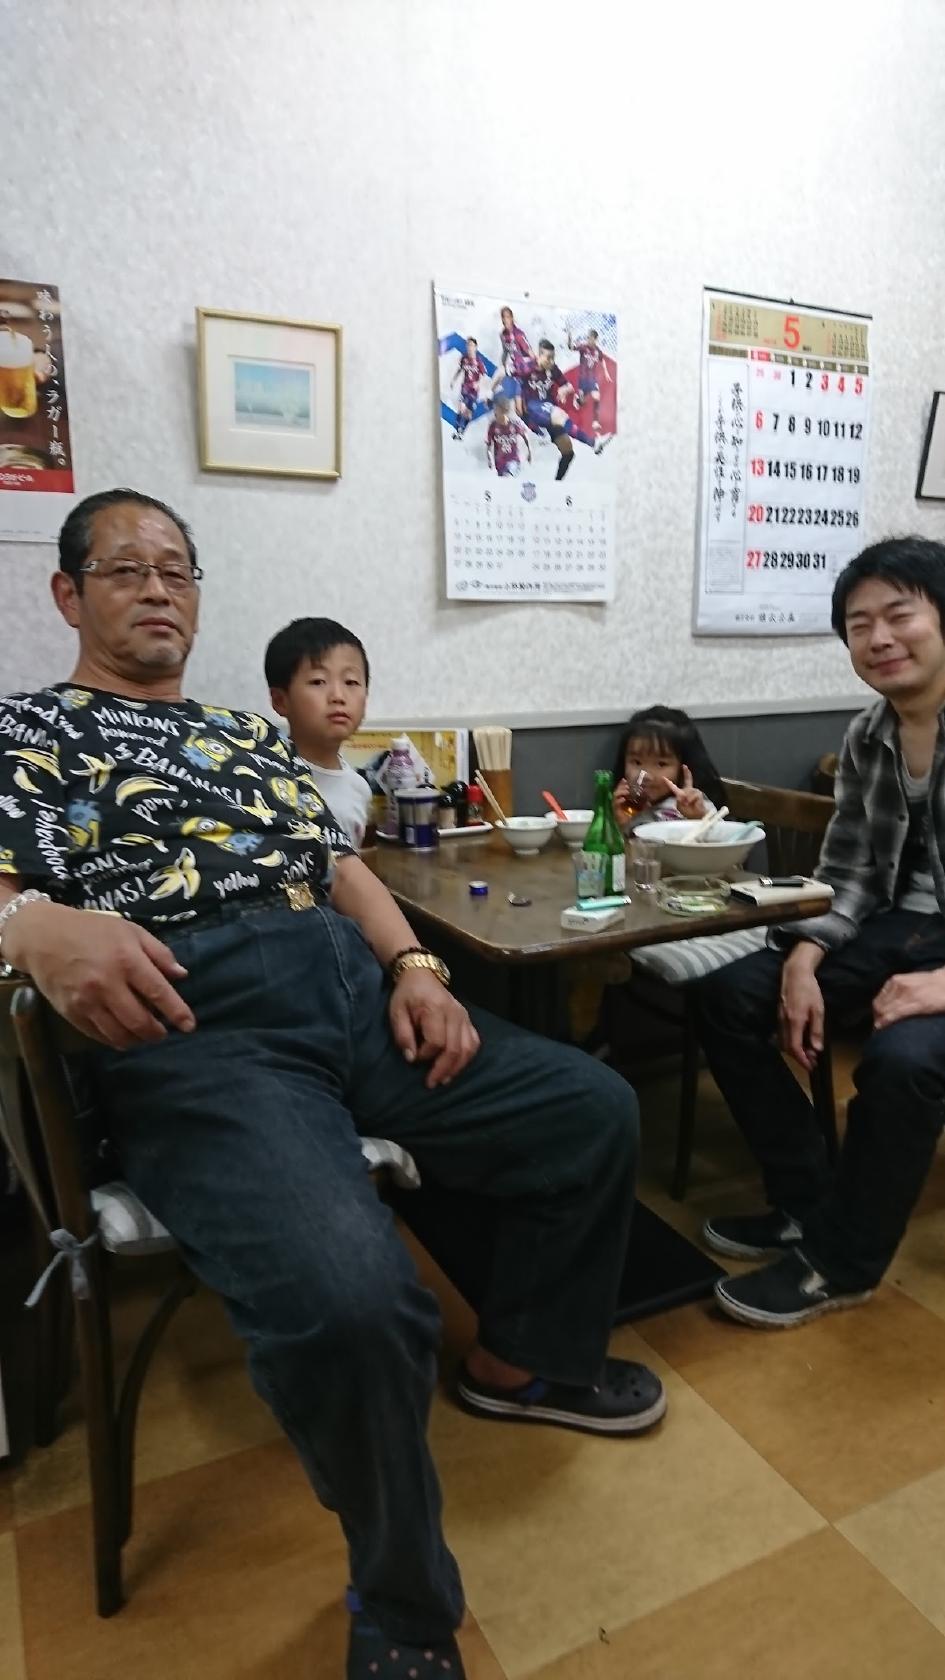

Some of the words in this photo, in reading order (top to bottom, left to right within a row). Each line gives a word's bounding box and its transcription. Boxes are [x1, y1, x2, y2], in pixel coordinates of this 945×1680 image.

[783, 314, 801, 350] 5
[790, 371, 796, 387] 1
[805, 372, 813, 388] 2
[820, 374, 829, 392] 3
[837, 376, 846, 393] 4
[854, 377, 863, 395] 5
[755, 410, 764, 430] 6
[772, 413, 780, 432] 7
[788, 416, 796, 433] 8
[804, 418, 811, 435] 9
[818, 420, 830, 437] 10
[834, 422, 845, 438] 11
[850, 424, 863, 440] 12
[751, 459, 764, 476] 13
[768, 461, 781, 478] 14
[784, 462, 797, 479] 15
[800, 464, 813, 480] 16
[816, 465, 828, 482] 17
[832, 466, 844, 483] 18
[848, 467, 860, 484] 19
[748, 505, 764, 522] 20
[766, 506, 780, 523] 21
[782, 507, 796, 524] 22
[797, 508, 812, 525] 23
[814, 509, 829, 525] 24
[830, 510, 844, 526] 25
[845, 511, 859, 528] 26
[747, 551, 760, 568] 27
[763, 552, 778, 569] 28
[780, 552, 794, 569] 29
[795, 553, 810, 570] 30
[813, 554, 826, 570] 31
